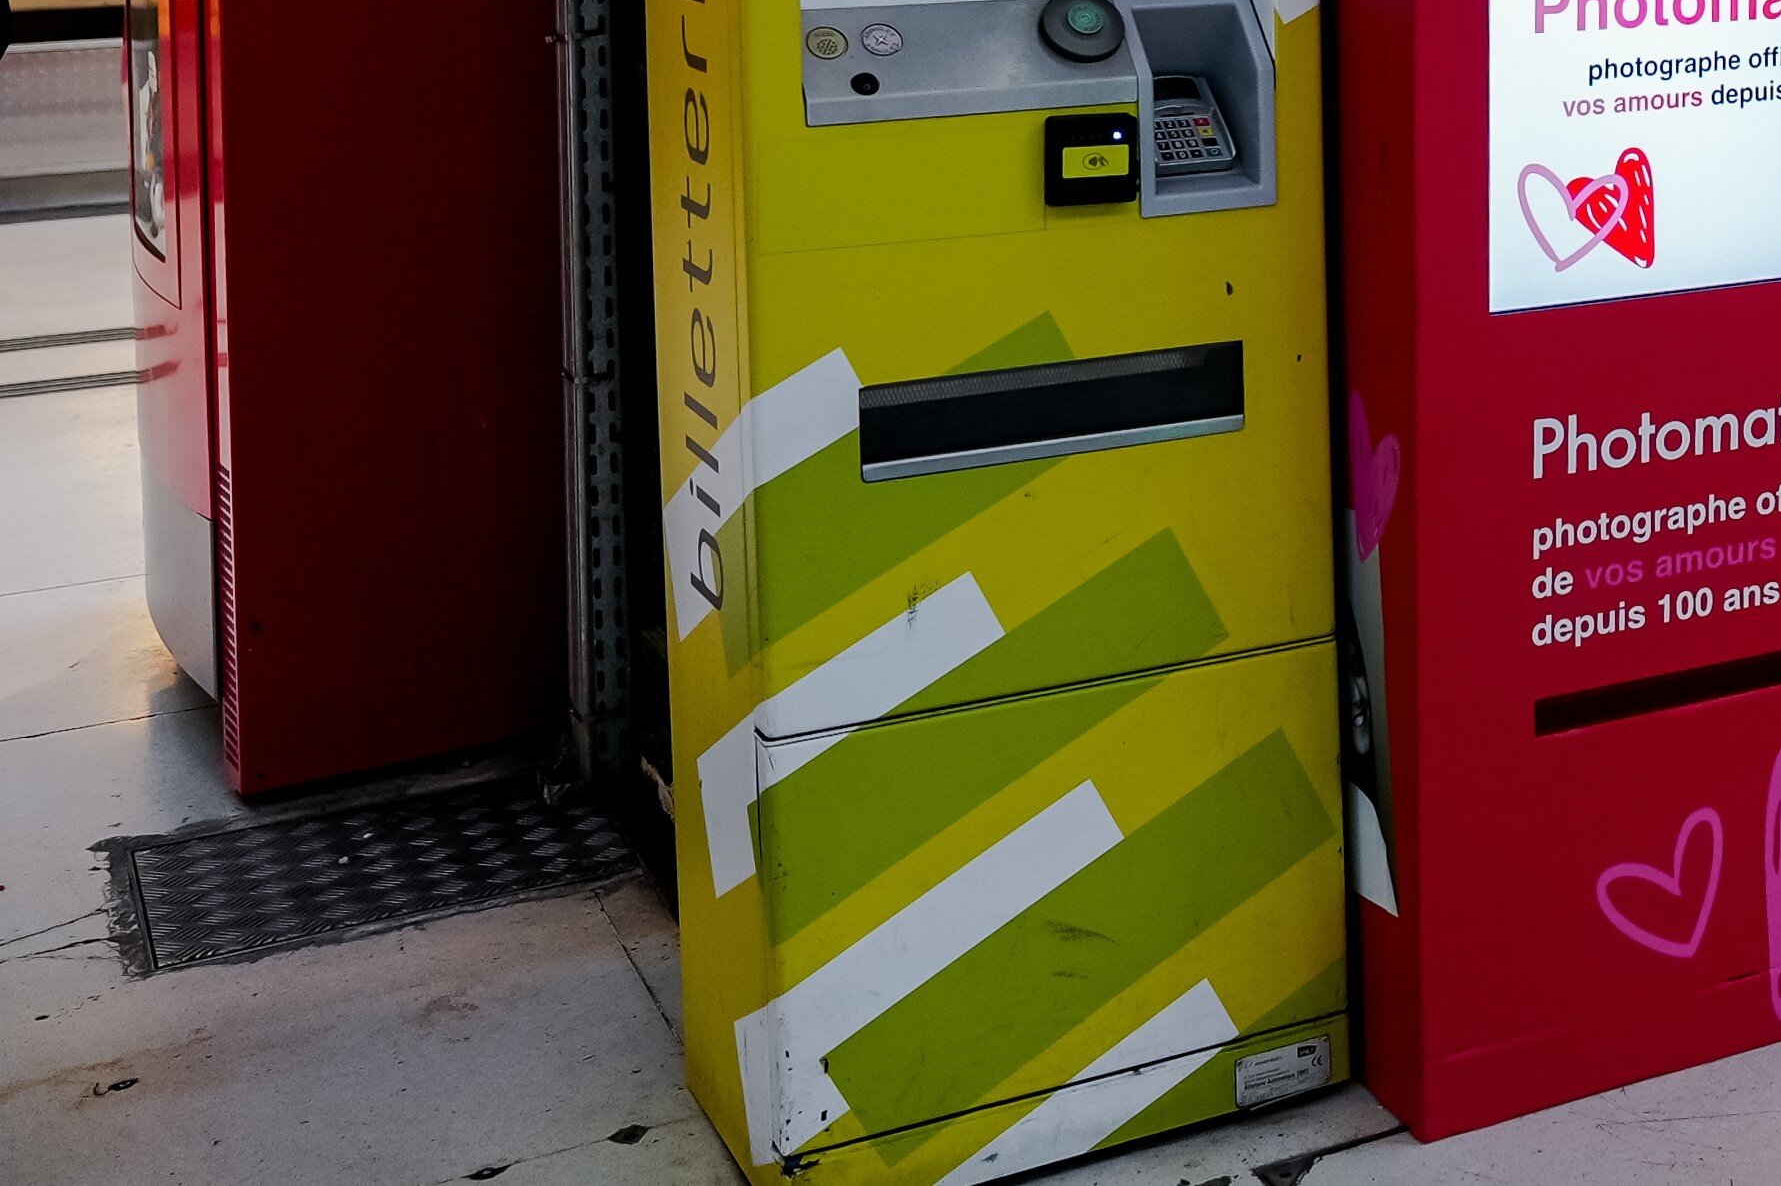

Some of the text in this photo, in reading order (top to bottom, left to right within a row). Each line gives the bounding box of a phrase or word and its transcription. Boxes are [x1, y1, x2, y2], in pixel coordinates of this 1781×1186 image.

[1588, 51, 1741, 86] photographe
[1562, 96, 1606, 117] vos
[1613, 91, 1703, 112] amours
[1533, 495, 1747, 559] photographe
[1531, 536, 1777, 599] de vos amours
[1531, 581, 1781, 646] depuis 100 ans
